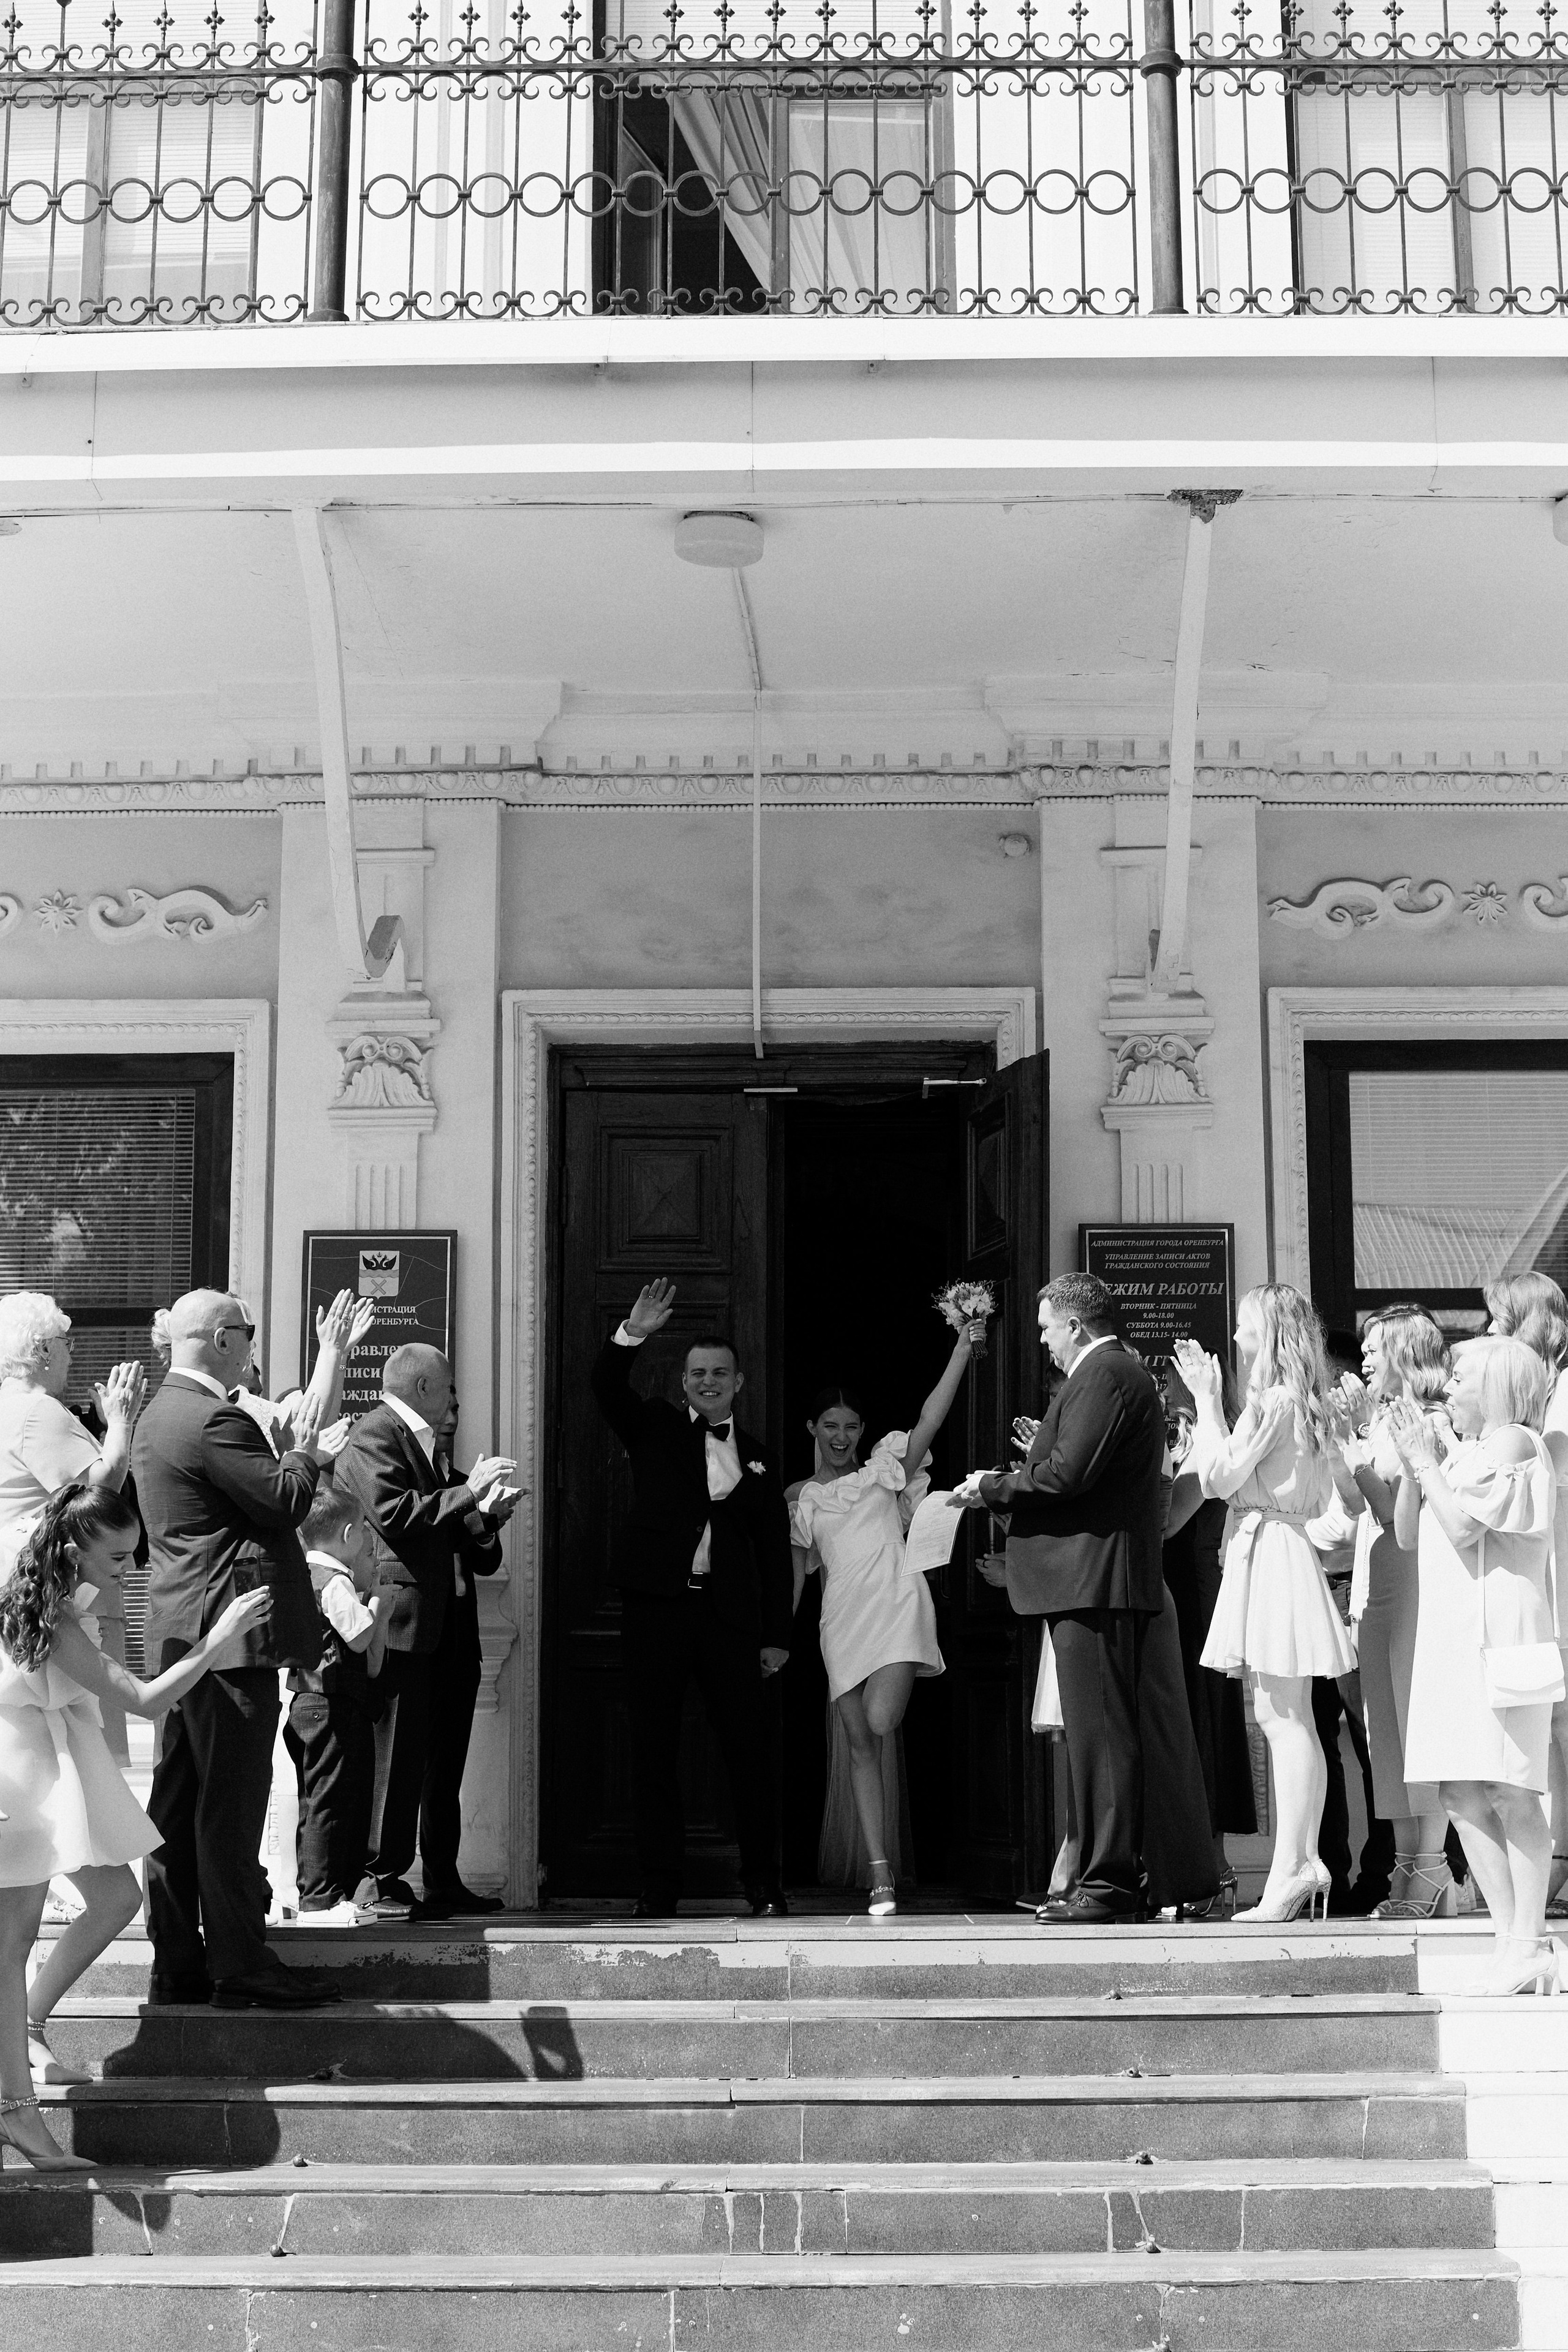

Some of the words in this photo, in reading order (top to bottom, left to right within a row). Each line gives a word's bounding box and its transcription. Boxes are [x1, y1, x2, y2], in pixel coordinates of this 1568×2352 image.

[1105, 1283, 1155, 1295] ЕЖИМ
[1156, 1283, 1224, 1295] РАБОТЫ
[371, 1306, 416, 1314] ИСТРАЦИЯ
[344, 1368, 380, 1378] писи
